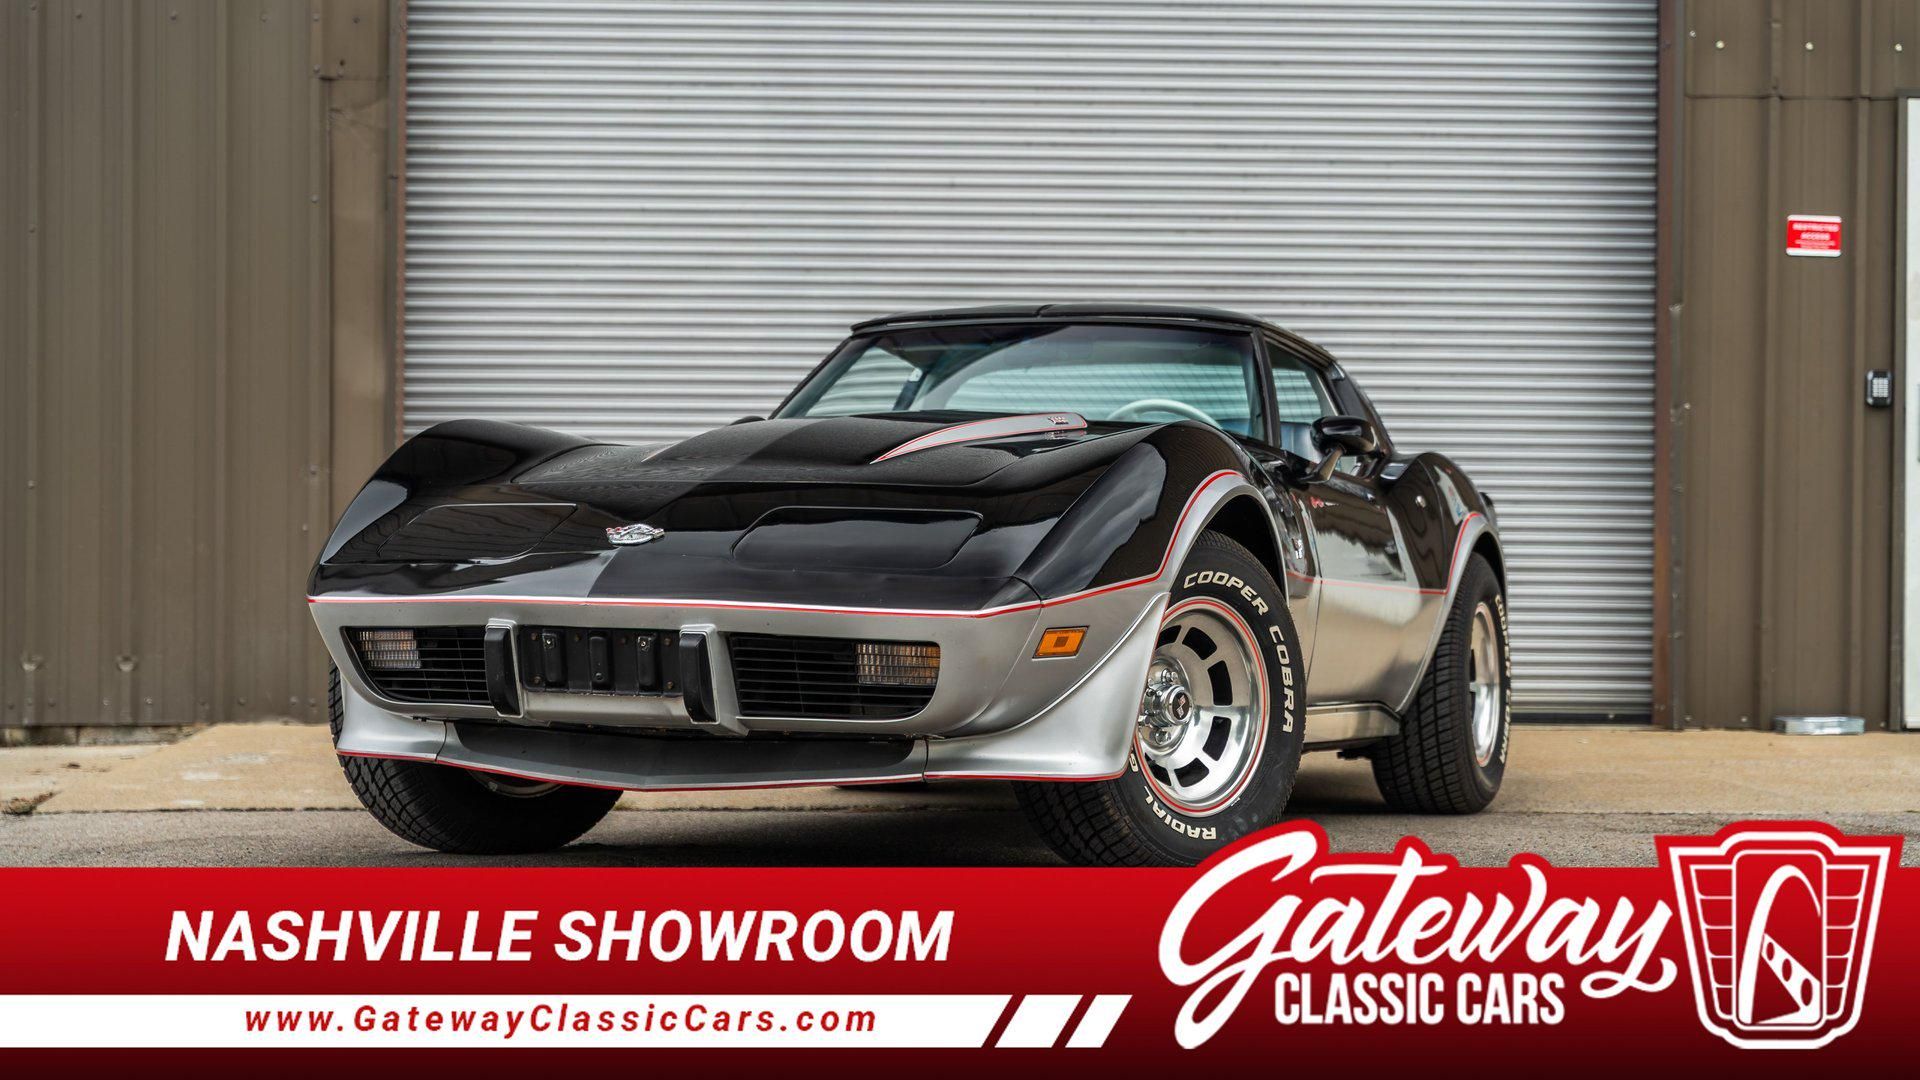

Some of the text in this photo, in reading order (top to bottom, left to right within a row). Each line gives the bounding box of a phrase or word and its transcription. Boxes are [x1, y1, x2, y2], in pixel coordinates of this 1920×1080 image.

[1183, 570, 1296, 733] COOPER COBRA
[1144, 785, 1217, 840] RADIAL
